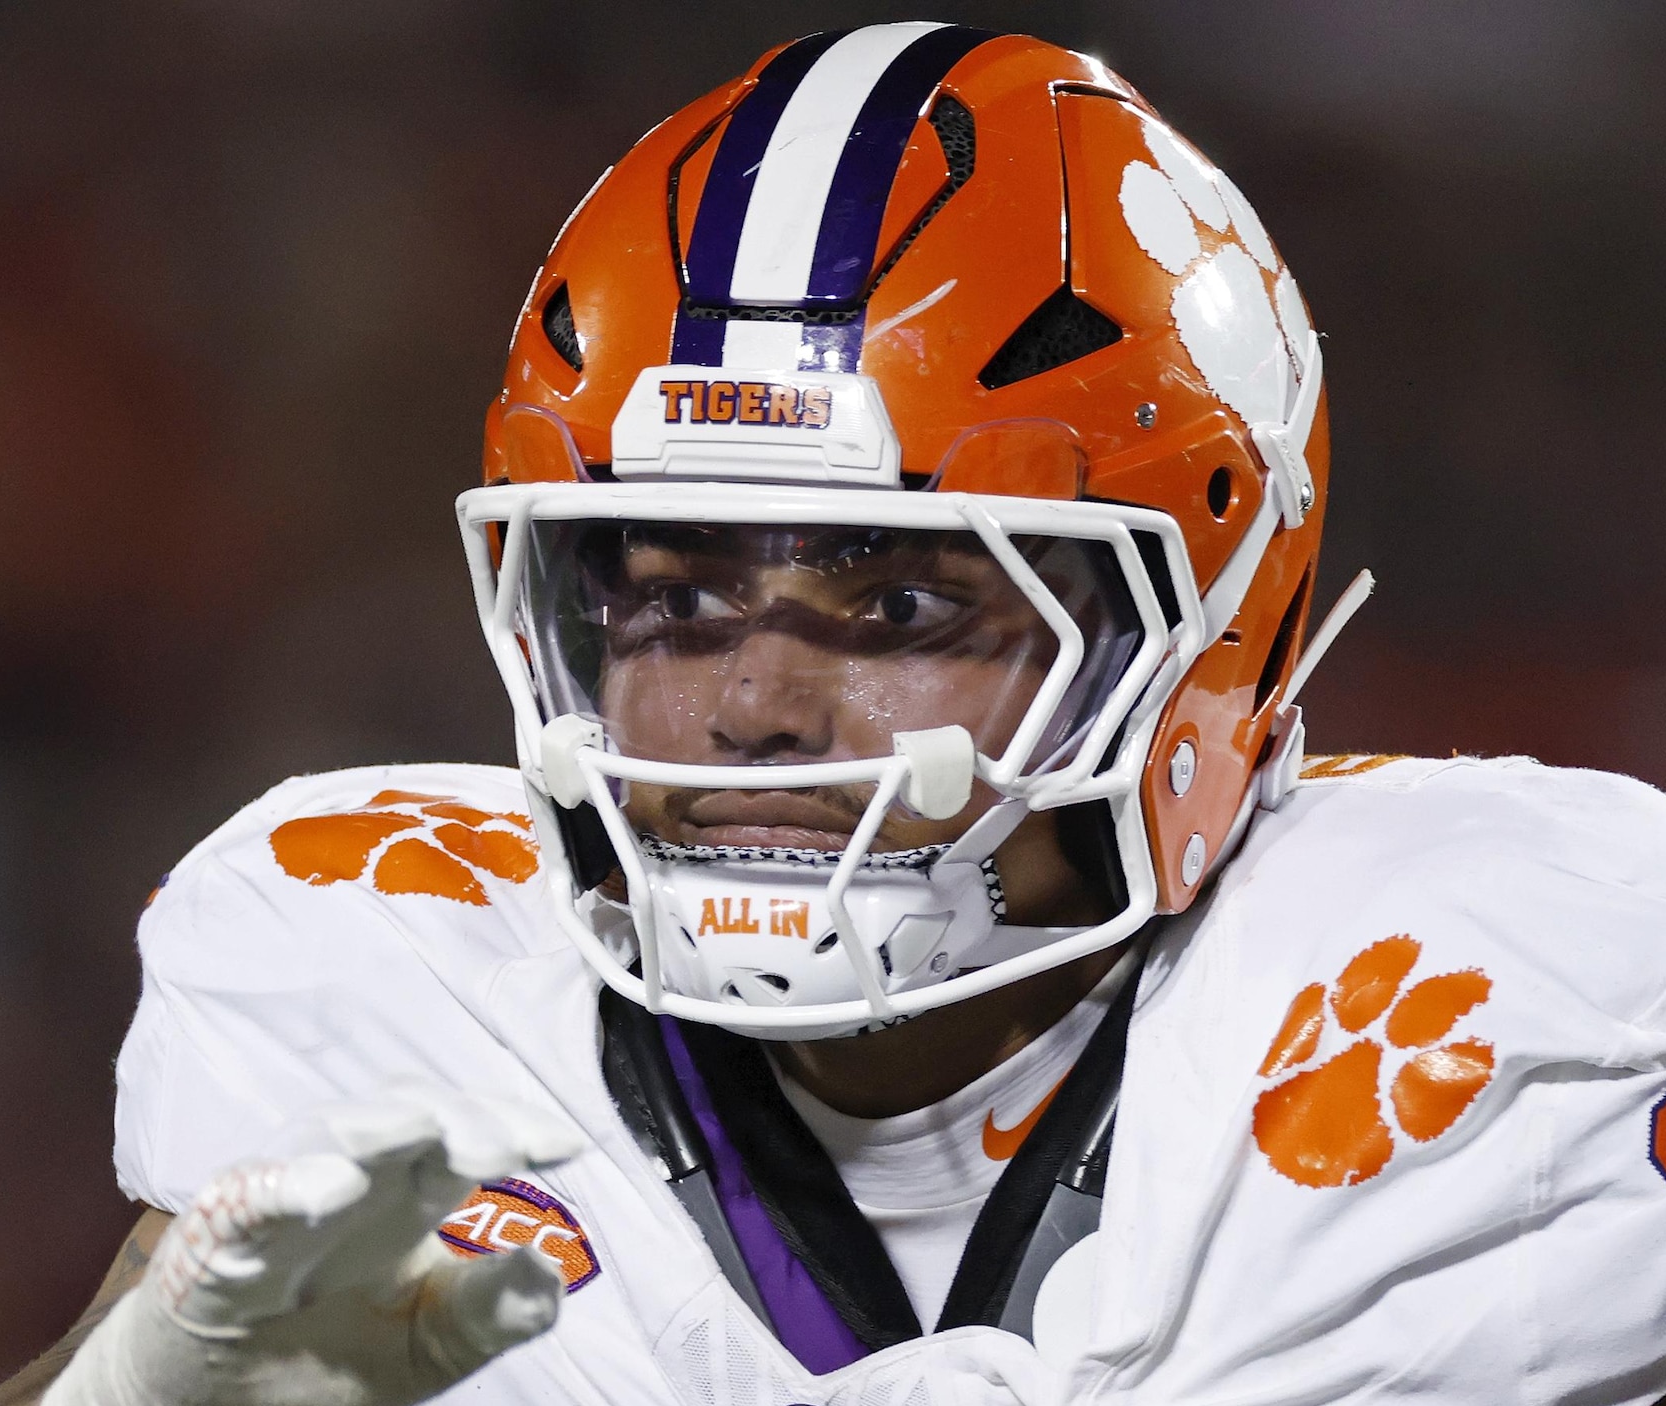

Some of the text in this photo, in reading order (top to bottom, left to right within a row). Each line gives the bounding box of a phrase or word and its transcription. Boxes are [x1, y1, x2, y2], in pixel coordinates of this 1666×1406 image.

[660, 380, 832, 429] TIGERS
[697, 897, 810, 939] ALL IN
[441, 1202, 579, 1266] ACC
